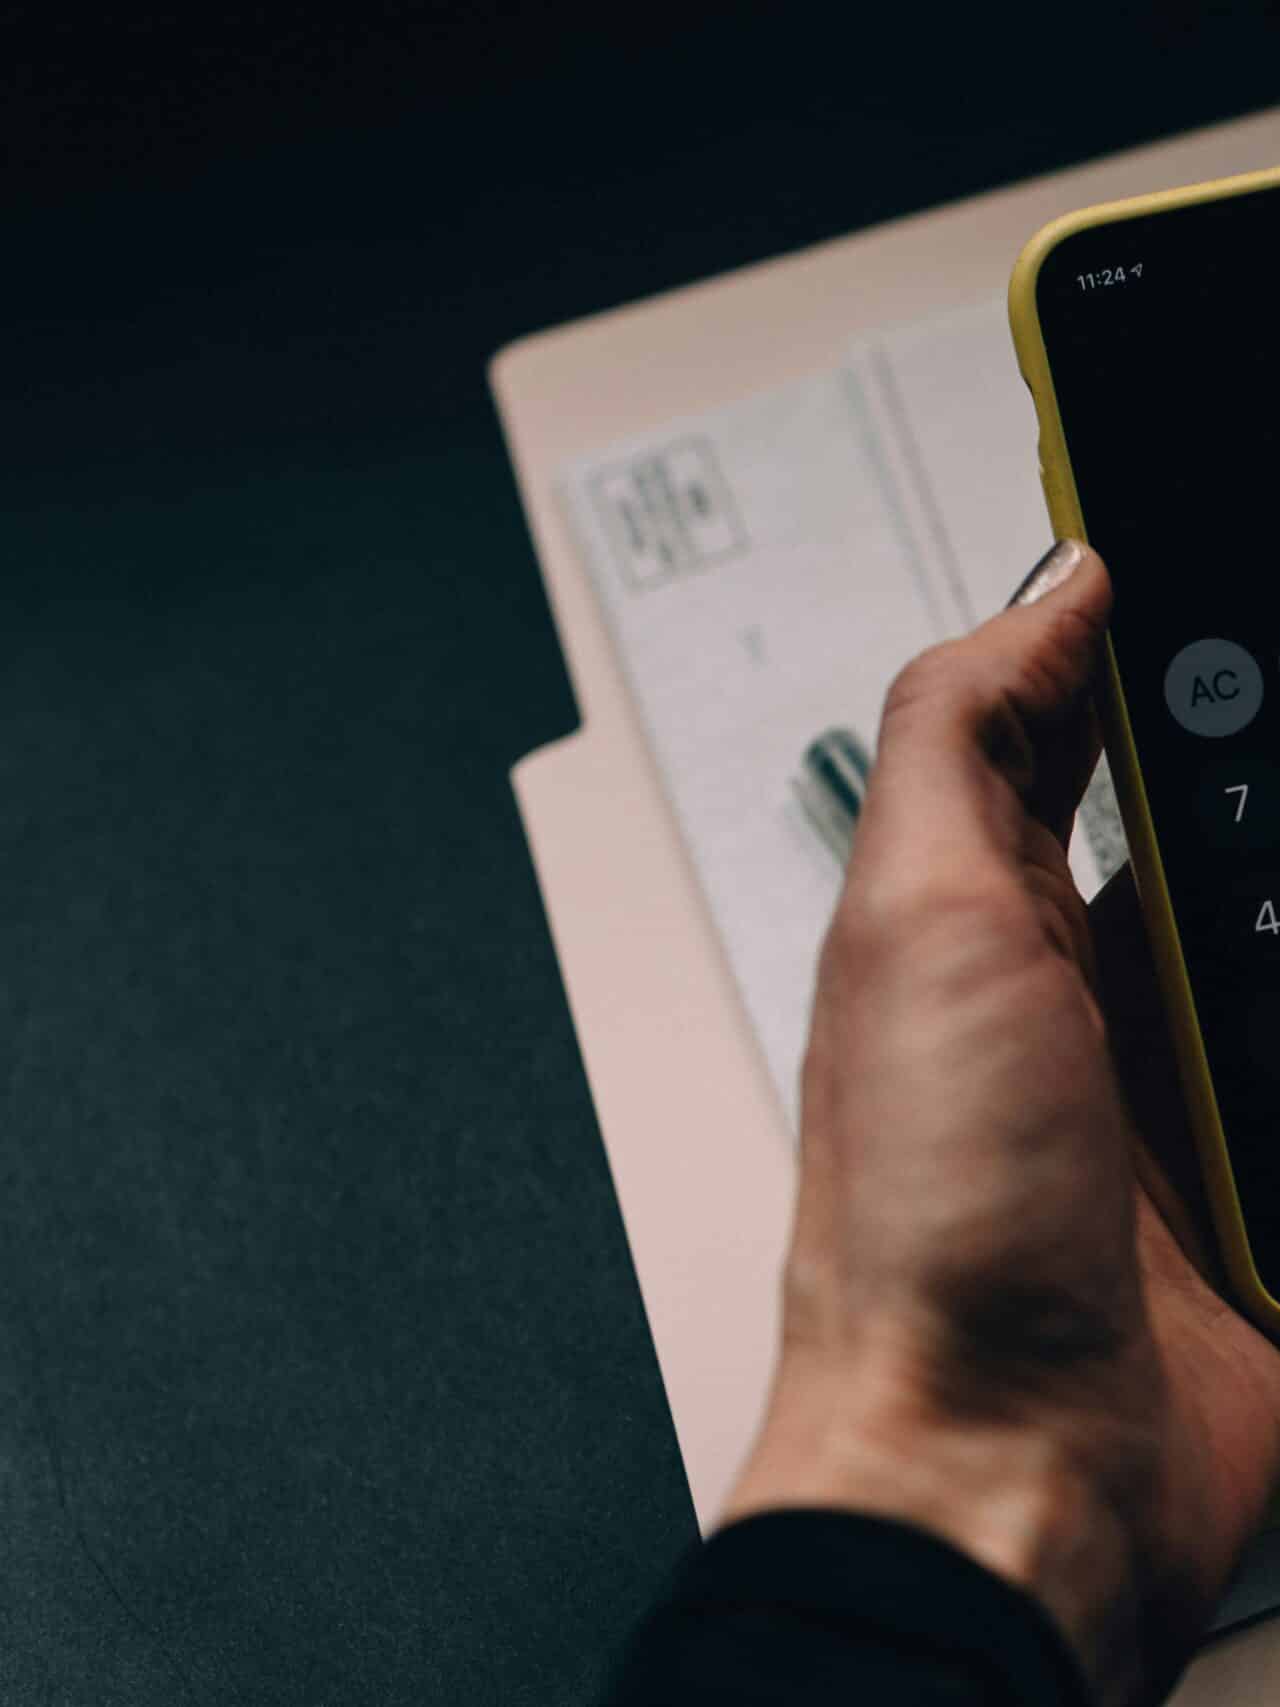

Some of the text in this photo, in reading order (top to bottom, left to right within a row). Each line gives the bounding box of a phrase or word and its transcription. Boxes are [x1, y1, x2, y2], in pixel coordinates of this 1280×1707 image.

[1076, 265, 1127, 291] 11:24
[1191, 669, 1241, 708] AC
[1224, 784, 1250, 823] 7
